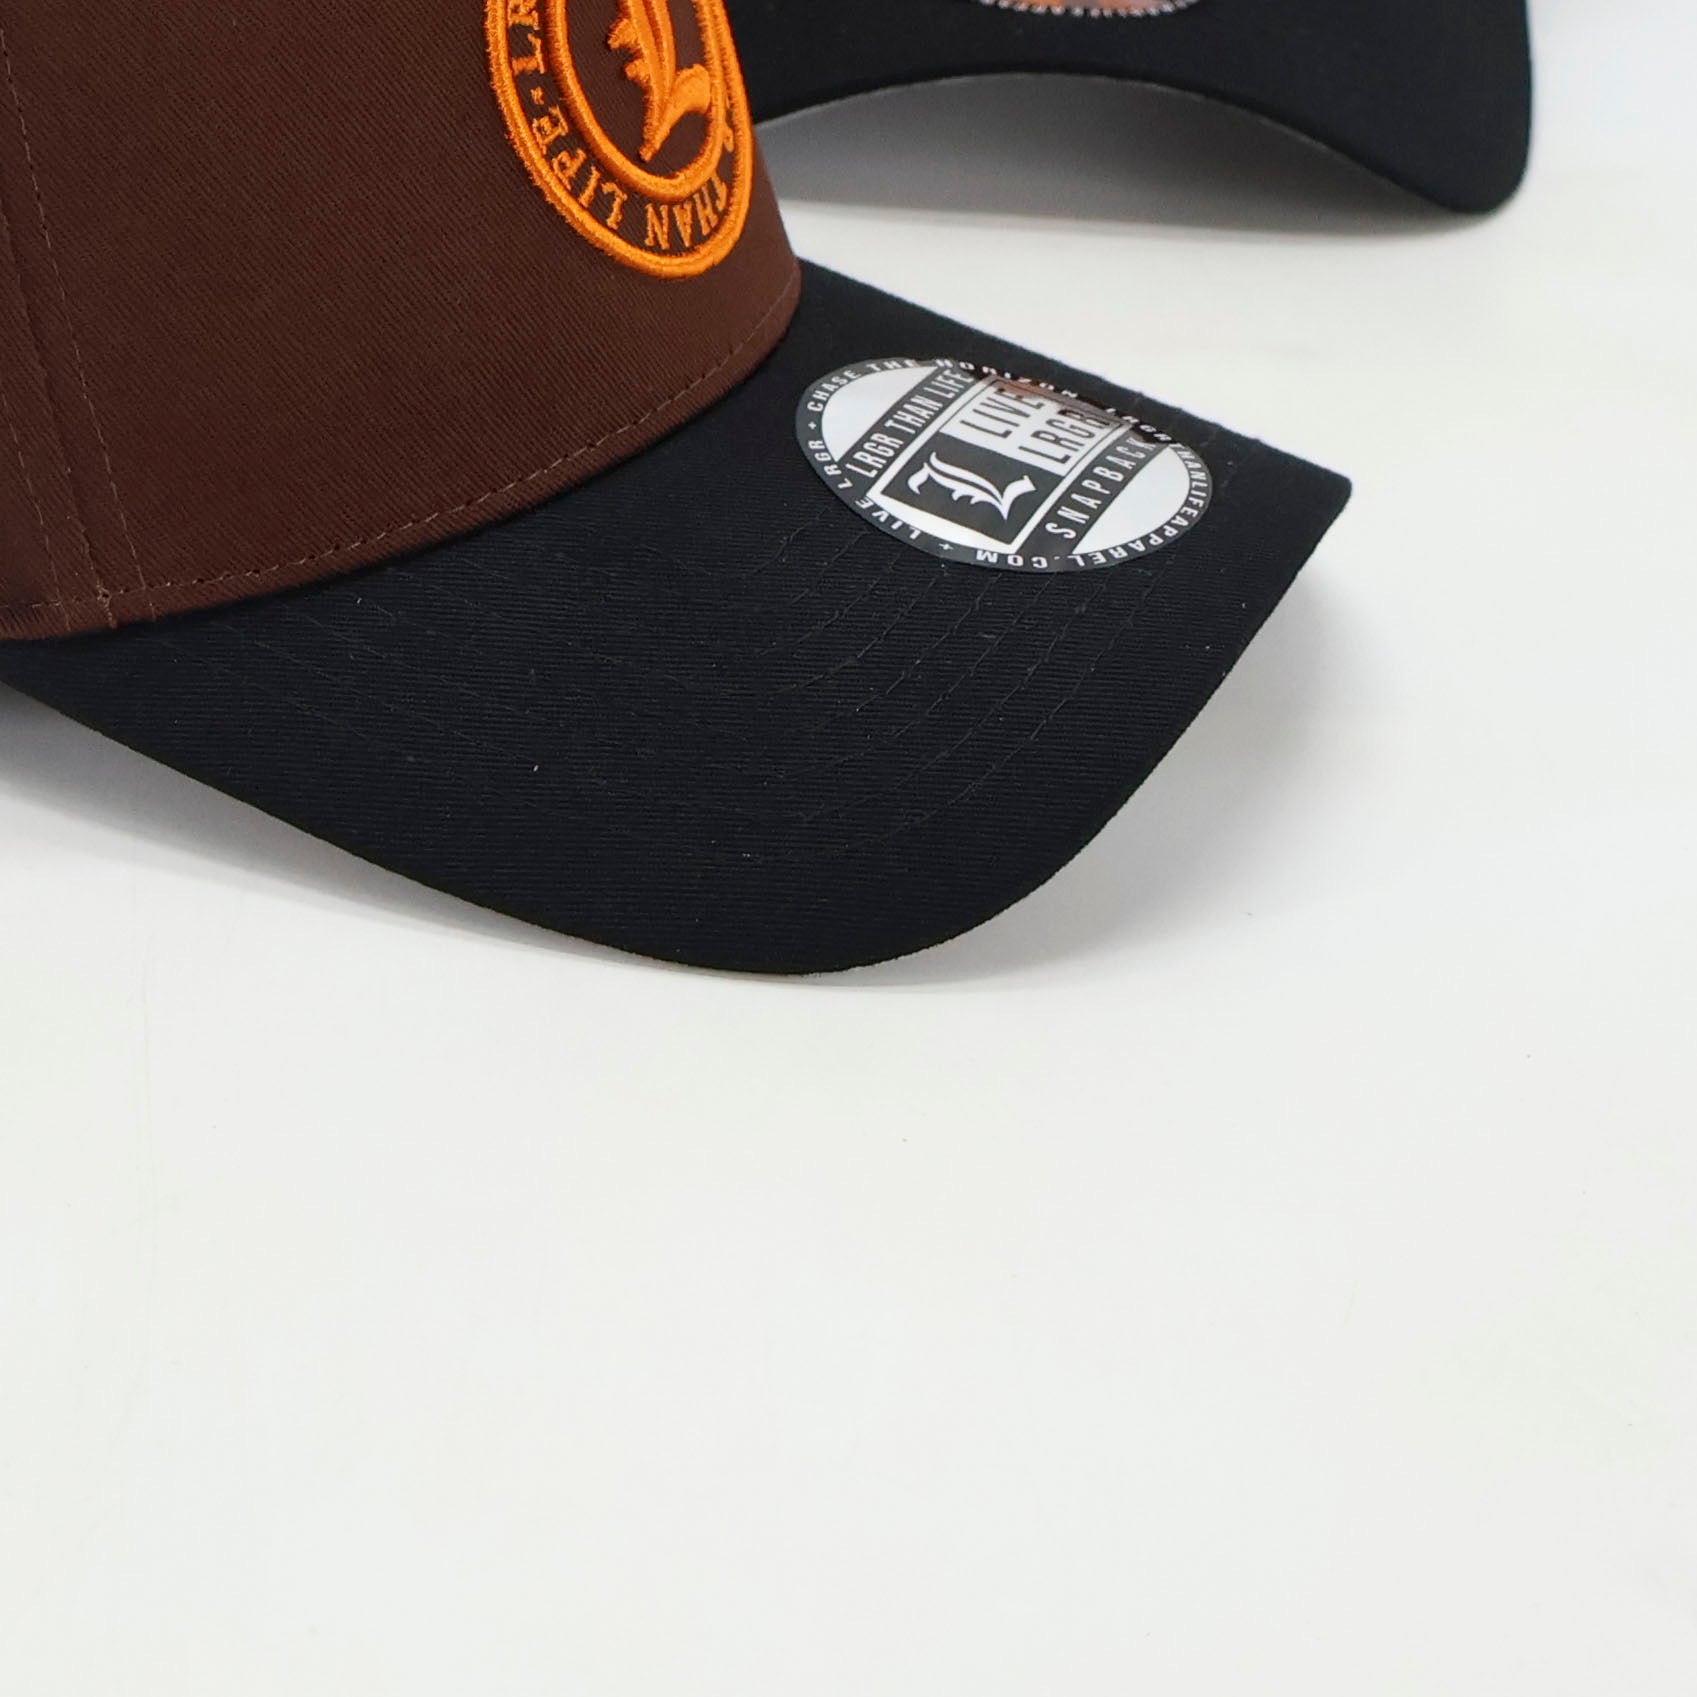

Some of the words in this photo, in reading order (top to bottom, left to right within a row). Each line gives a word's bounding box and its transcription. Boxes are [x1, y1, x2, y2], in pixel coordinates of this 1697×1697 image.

[530, 101, 629, 230] LIFE
[806, 368, 862, 413] CHASE
[959, 385, 1045, 439] LIVE
[845, 432, 905, 479] LRGR
[884, 394, 944, 435] THAN
[923, 369, 975, 399] LIFE
[1018, 408, 1112, 464] LRGR
[807, 438, 854, 491] LRGR
[906, 451, 1037, 521] L
[1045, 436, 1157, 540] SNAPBACK
[854, 497, 922, 540] LIVE
